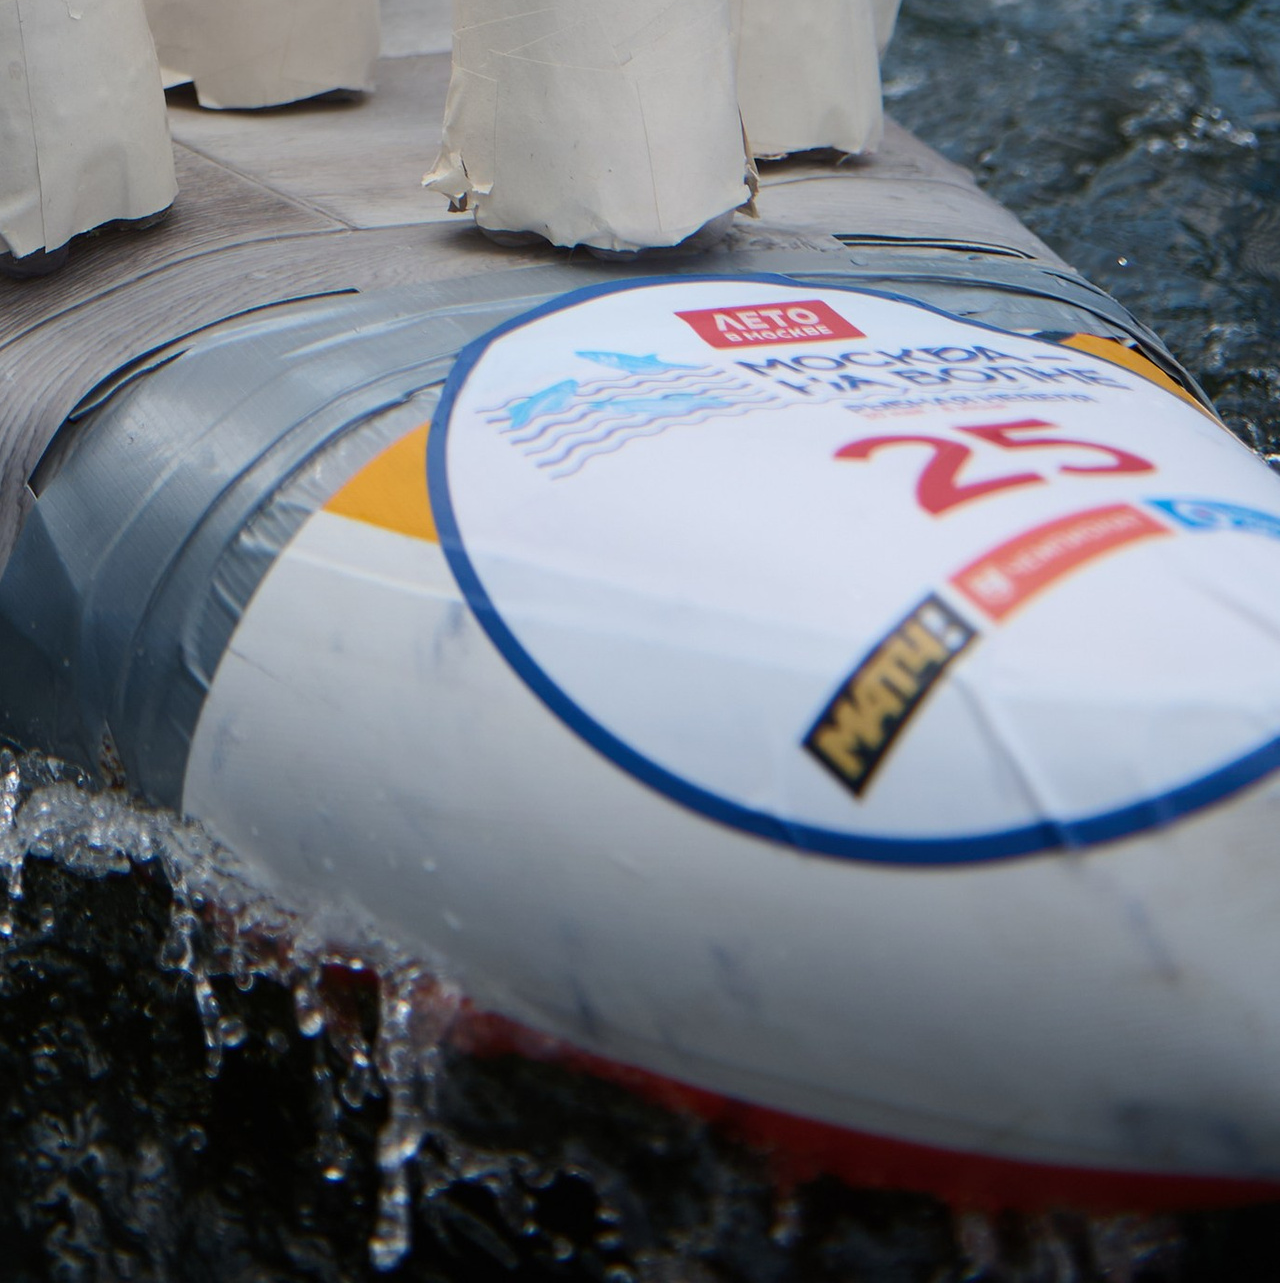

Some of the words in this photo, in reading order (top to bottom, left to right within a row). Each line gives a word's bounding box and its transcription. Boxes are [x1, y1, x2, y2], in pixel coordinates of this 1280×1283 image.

[712, 306, 820, 332] ЛЕТО
[723, 331, 743, 343] В
[745, 324, 833, 341] МОСКВЕ
[733, 344, 1032, 377] МОСКВА
[831, 418, 1157, 518] 25
